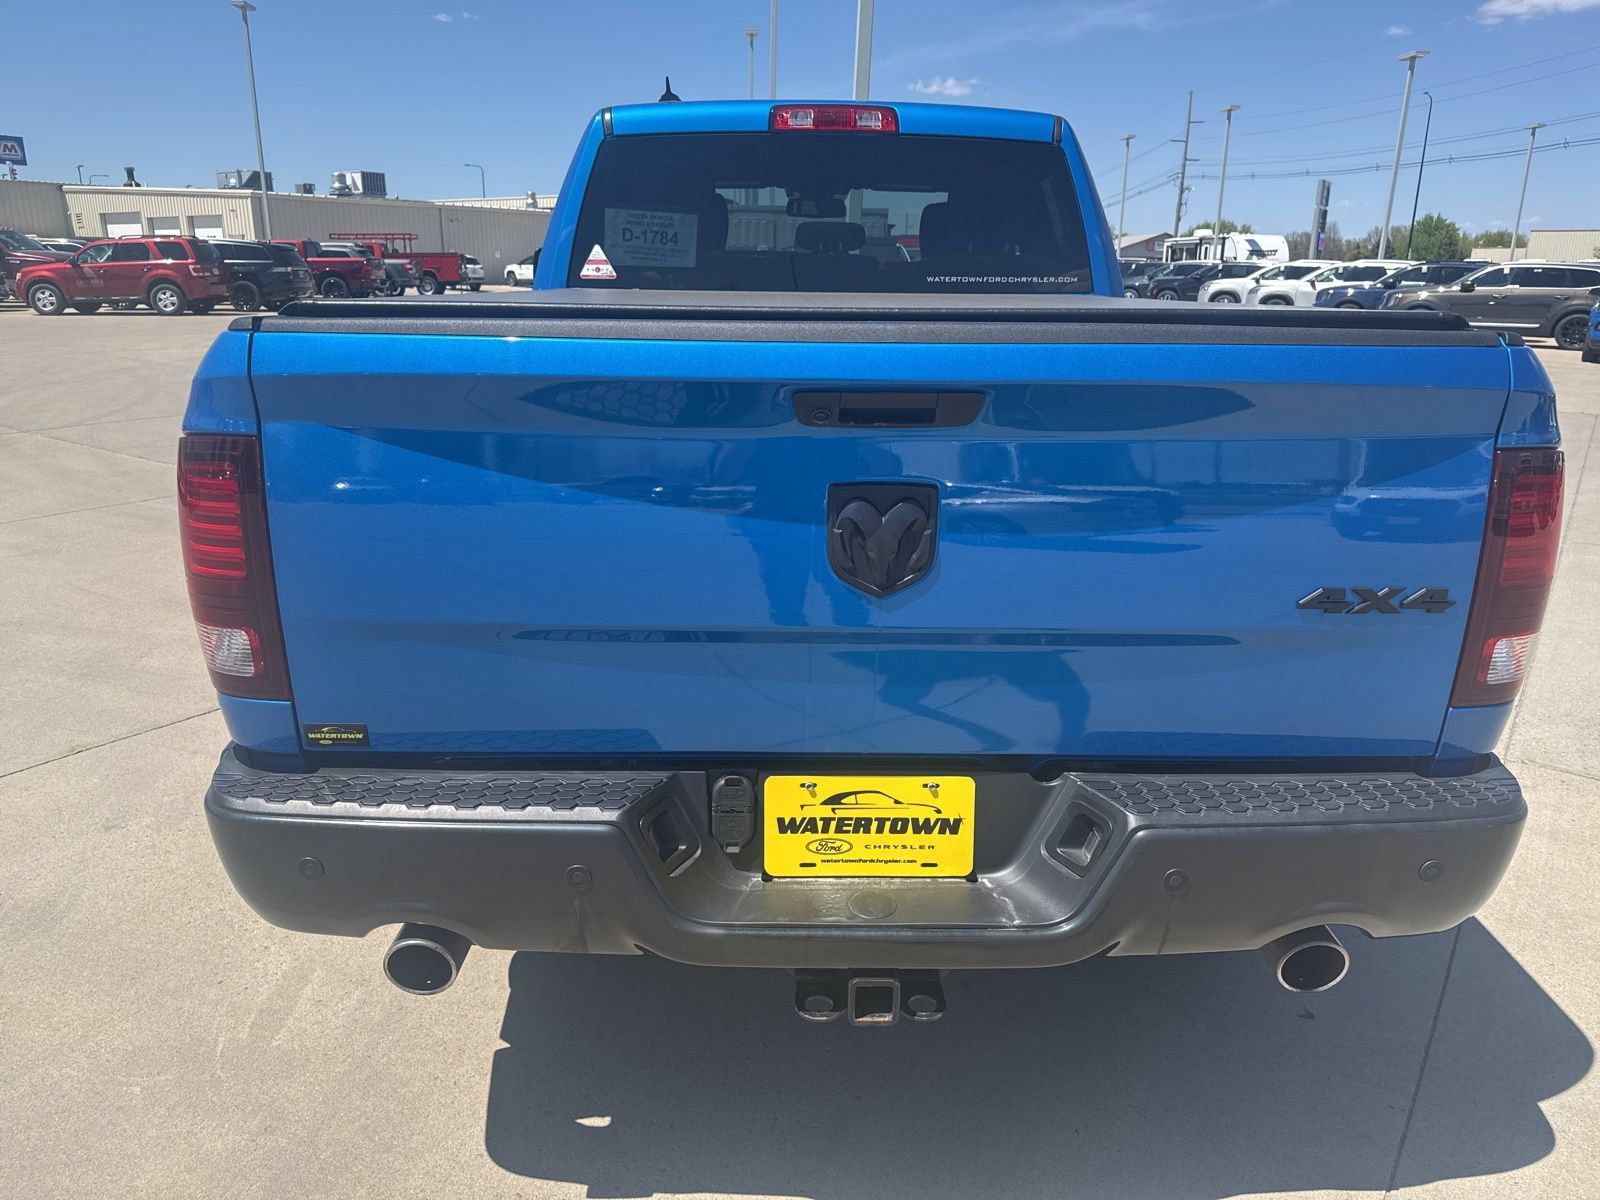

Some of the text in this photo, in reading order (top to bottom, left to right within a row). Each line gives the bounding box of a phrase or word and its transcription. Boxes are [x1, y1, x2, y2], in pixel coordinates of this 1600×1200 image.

[622, 227, 679, 247] D-1784
[1296, 587, 1457, 614] 4X4
[776, 816, 963, 836] WATERTOWN
[815, 840, 843, 852] Ford
